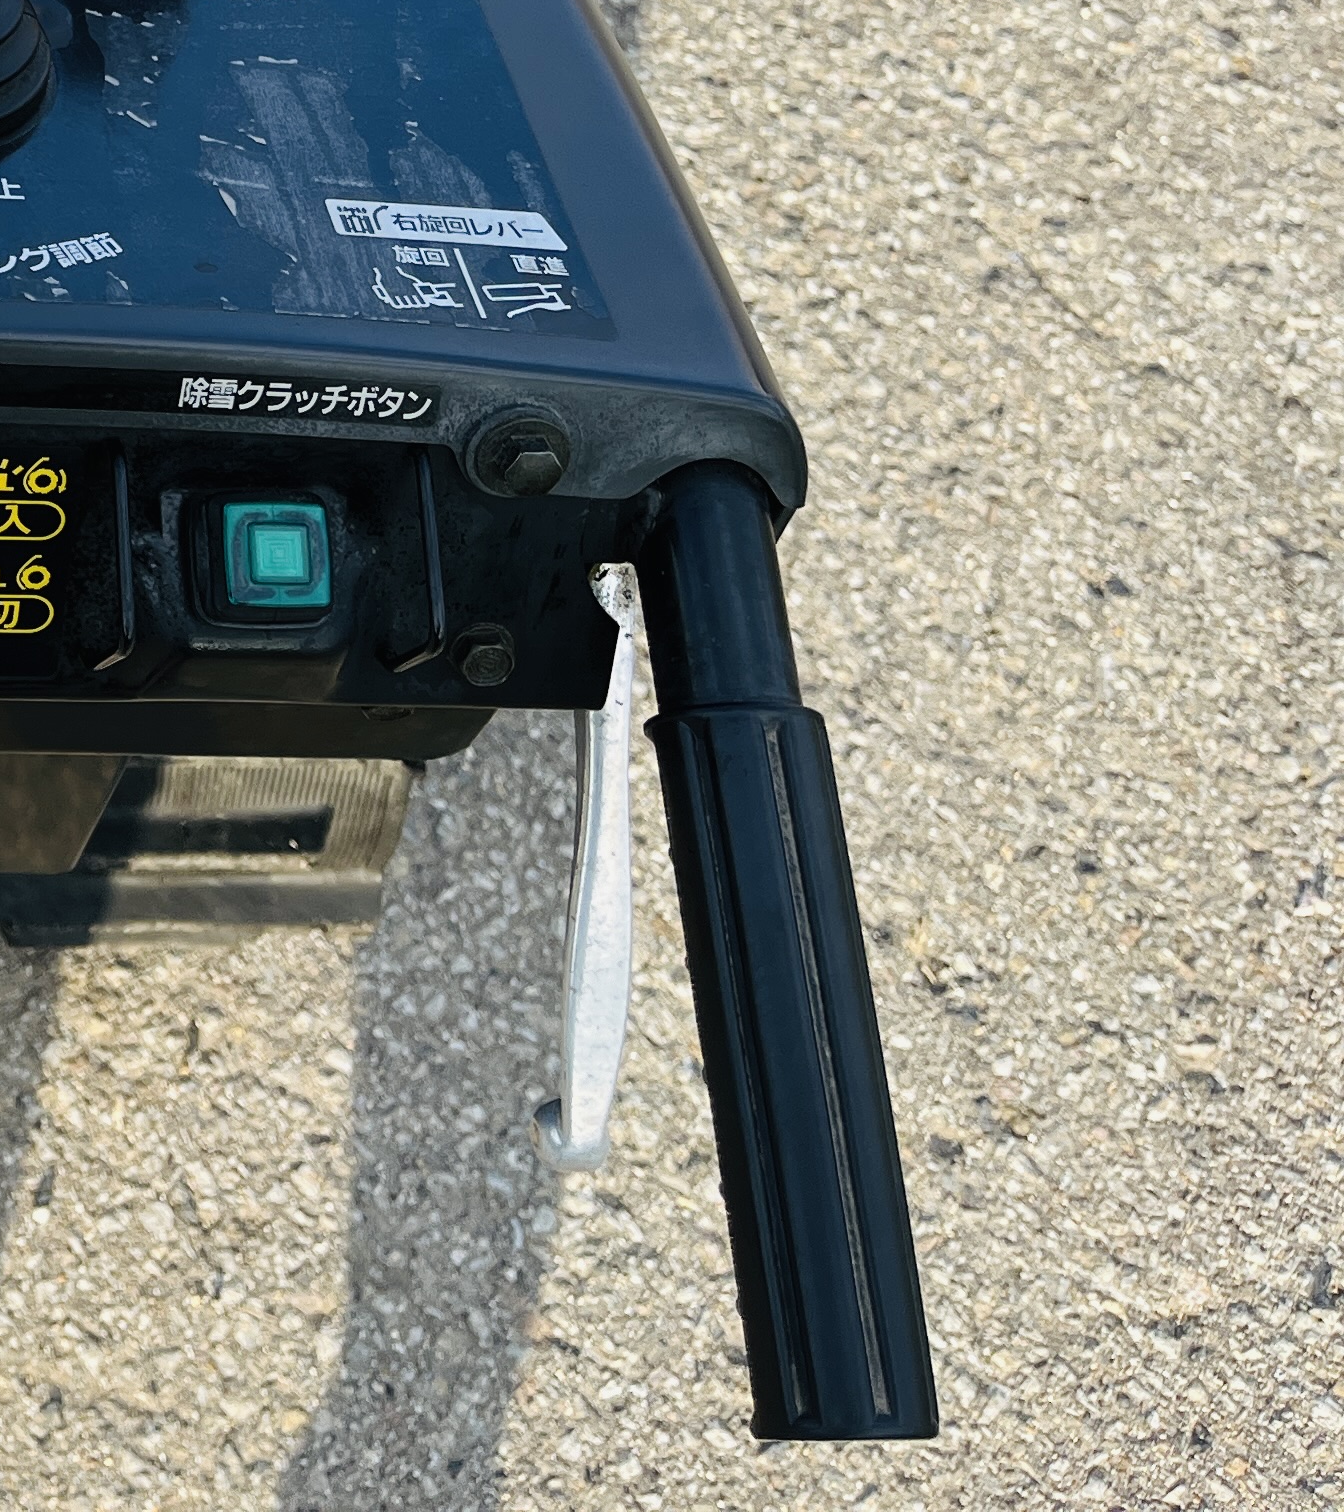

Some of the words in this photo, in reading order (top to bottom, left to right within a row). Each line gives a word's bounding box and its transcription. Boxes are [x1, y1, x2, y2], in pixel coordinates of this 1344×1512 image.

[390, 212, 544, 239] 右旋回レバー
[391, 244, 451, 268] 旋回
[509, 253, 571, 277] 直進
[178, 376, 432, 421] 除雪クラッチボタン
